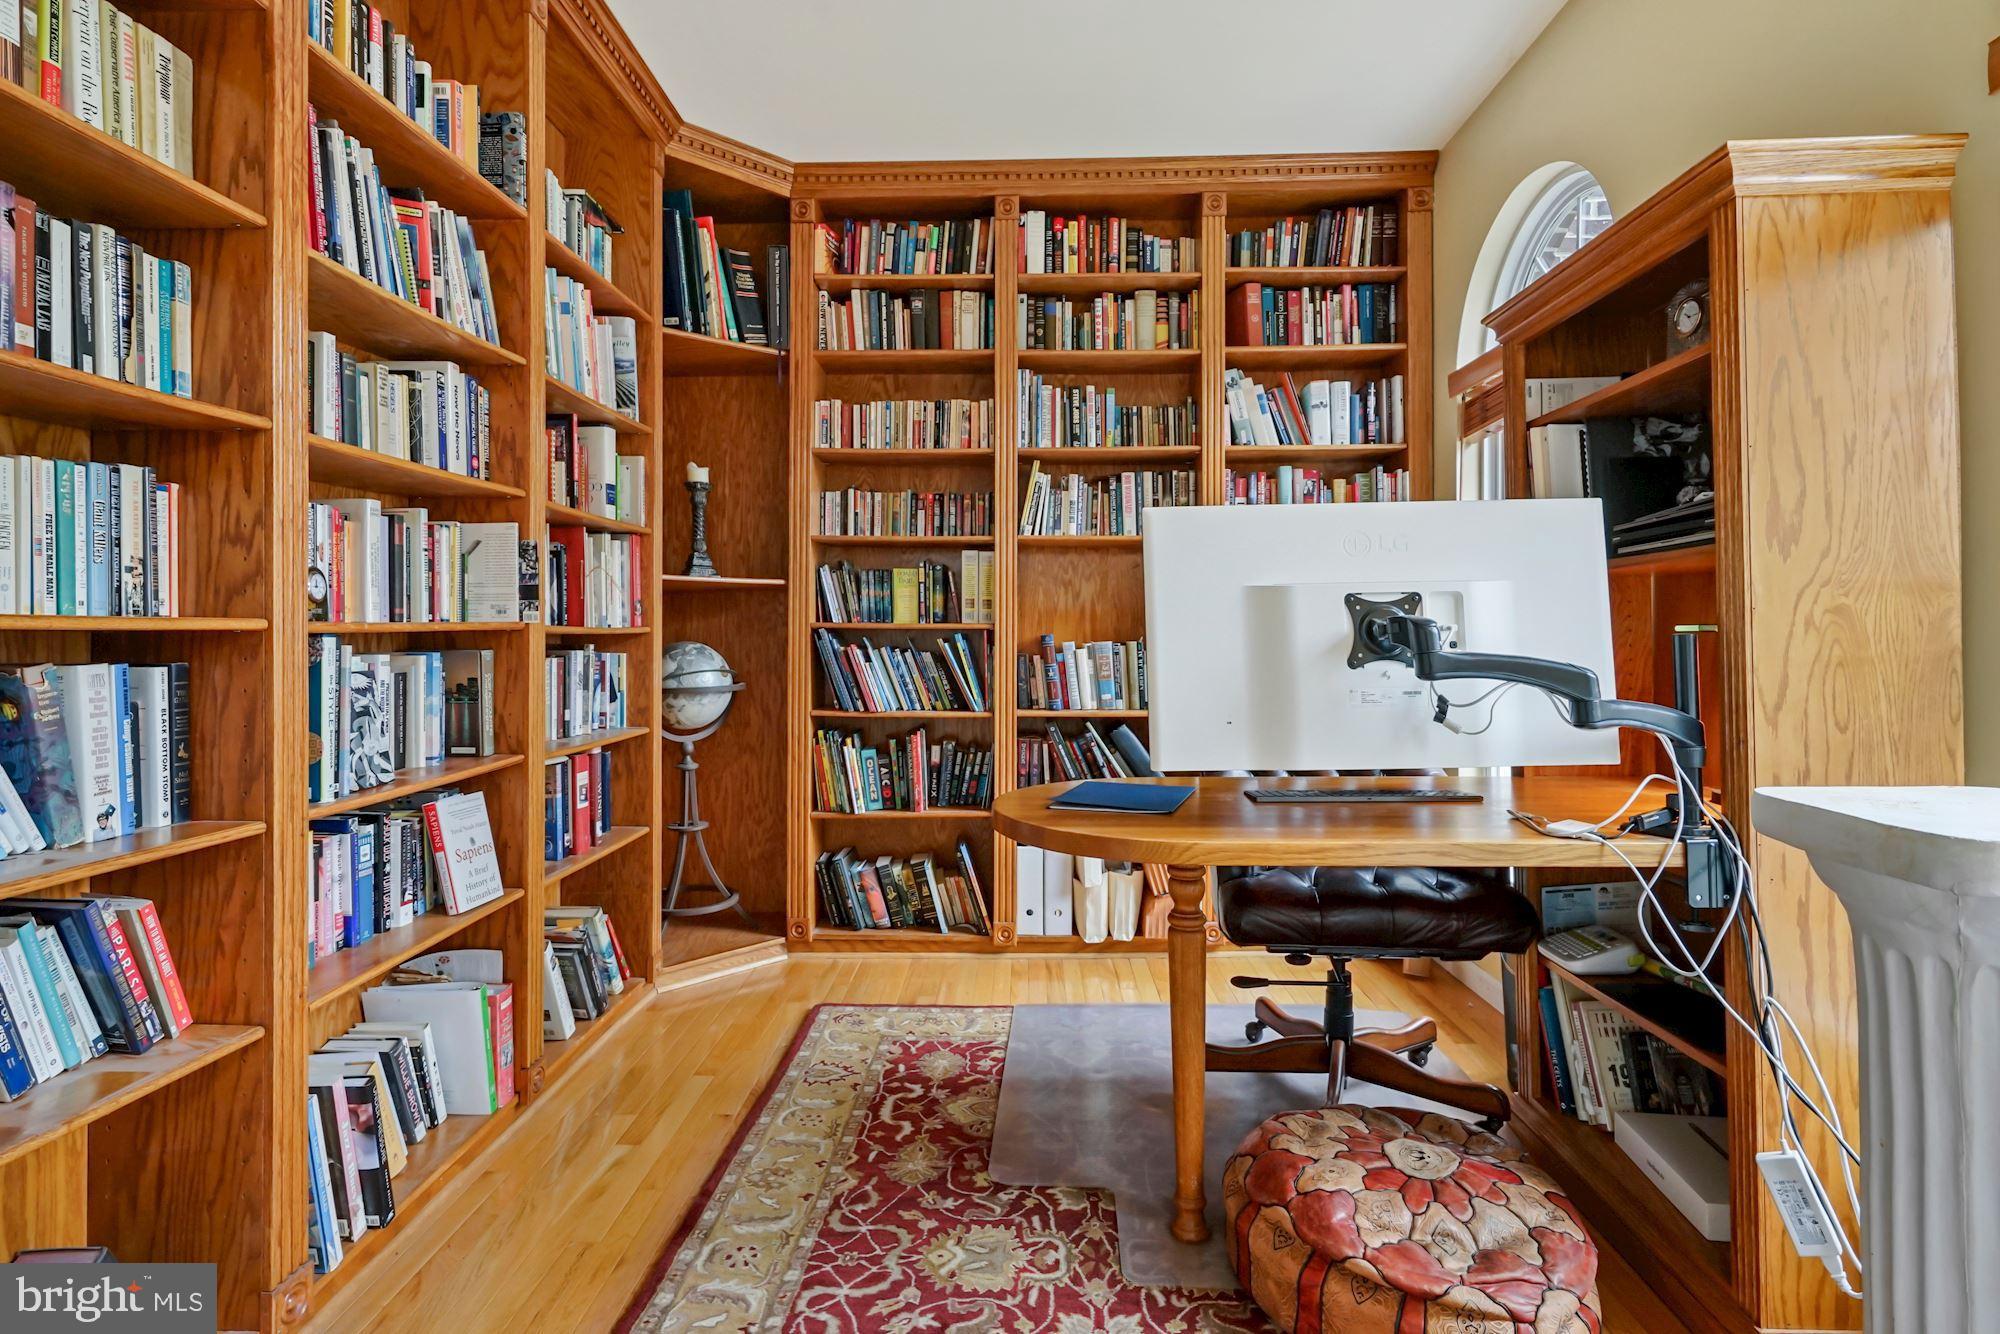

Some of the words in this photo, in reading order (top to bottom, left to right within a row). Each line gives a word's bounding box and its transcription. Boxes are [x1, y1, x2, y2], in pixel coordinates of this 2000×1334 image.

[372, 12, 381, 42] LEWIS
[50, 18, 60, 61] WATCHMAN
[109, 9, 120, 87] Post-Conservative
[80, 50, 91, 70] on
[81, 74, 98, 97] the
[156, 53, 171, 104] Telephone
[112, 87, 121, 124] America
[79, 231, 90, 249] The
[79, 250, 90, 270] New
[37, 270, 50, 308] MEDIA
[79, 271, 92, 317] Populism
[111, 287, 118, 297] OF
[38, 310, 51, 332] LAB
[1072, 388, 1080, 407] STEVE
[1072, 407, 1080, 424] JOBS
[45, 513, 53, 534] FREE
[93, 499, 106, 527] Giant
[45, 536, 53, 552] THE
[92, 529, 106, 564] Killers
[1378, 533, 1408, 553] LG
[45, 554, 53, 576] MALE
[45, 577, 53, 599] MAN!
[866, 758, 877, 801] OCEAN
[428, 810, 443, 848] SAPIENS
[455, 842, 493, 863] Sapiens
[468, 869, 473, 877] A
[475, 863, 489, 874] Brief
[466, 879, 488, 892] History
[489, 872, 496, 881] of
[466, 886, 500, 905] Humankind
[146, 915, 157, 927] HOW
[150, 927, 160, 937] TO
[152, 936, 166, 955] RAISE
[114, 934, 140, 990] PARIS
[157, 953, 167, 962] AN
[159, 960, 174, 978] ADULT
[1595, 1012, 1614, 1024] THE
[1549, 1049, 1557, 1066] THE
[1553, 1067, 1561, 1088] CELTS
[398, 1053, 412, 1089] WILLIE
[405, 1089, 421, 1124] BROWN
[372, 1086, 383, 1117] UNDER
[376, 1118, 388, 1166] PRESSURE
